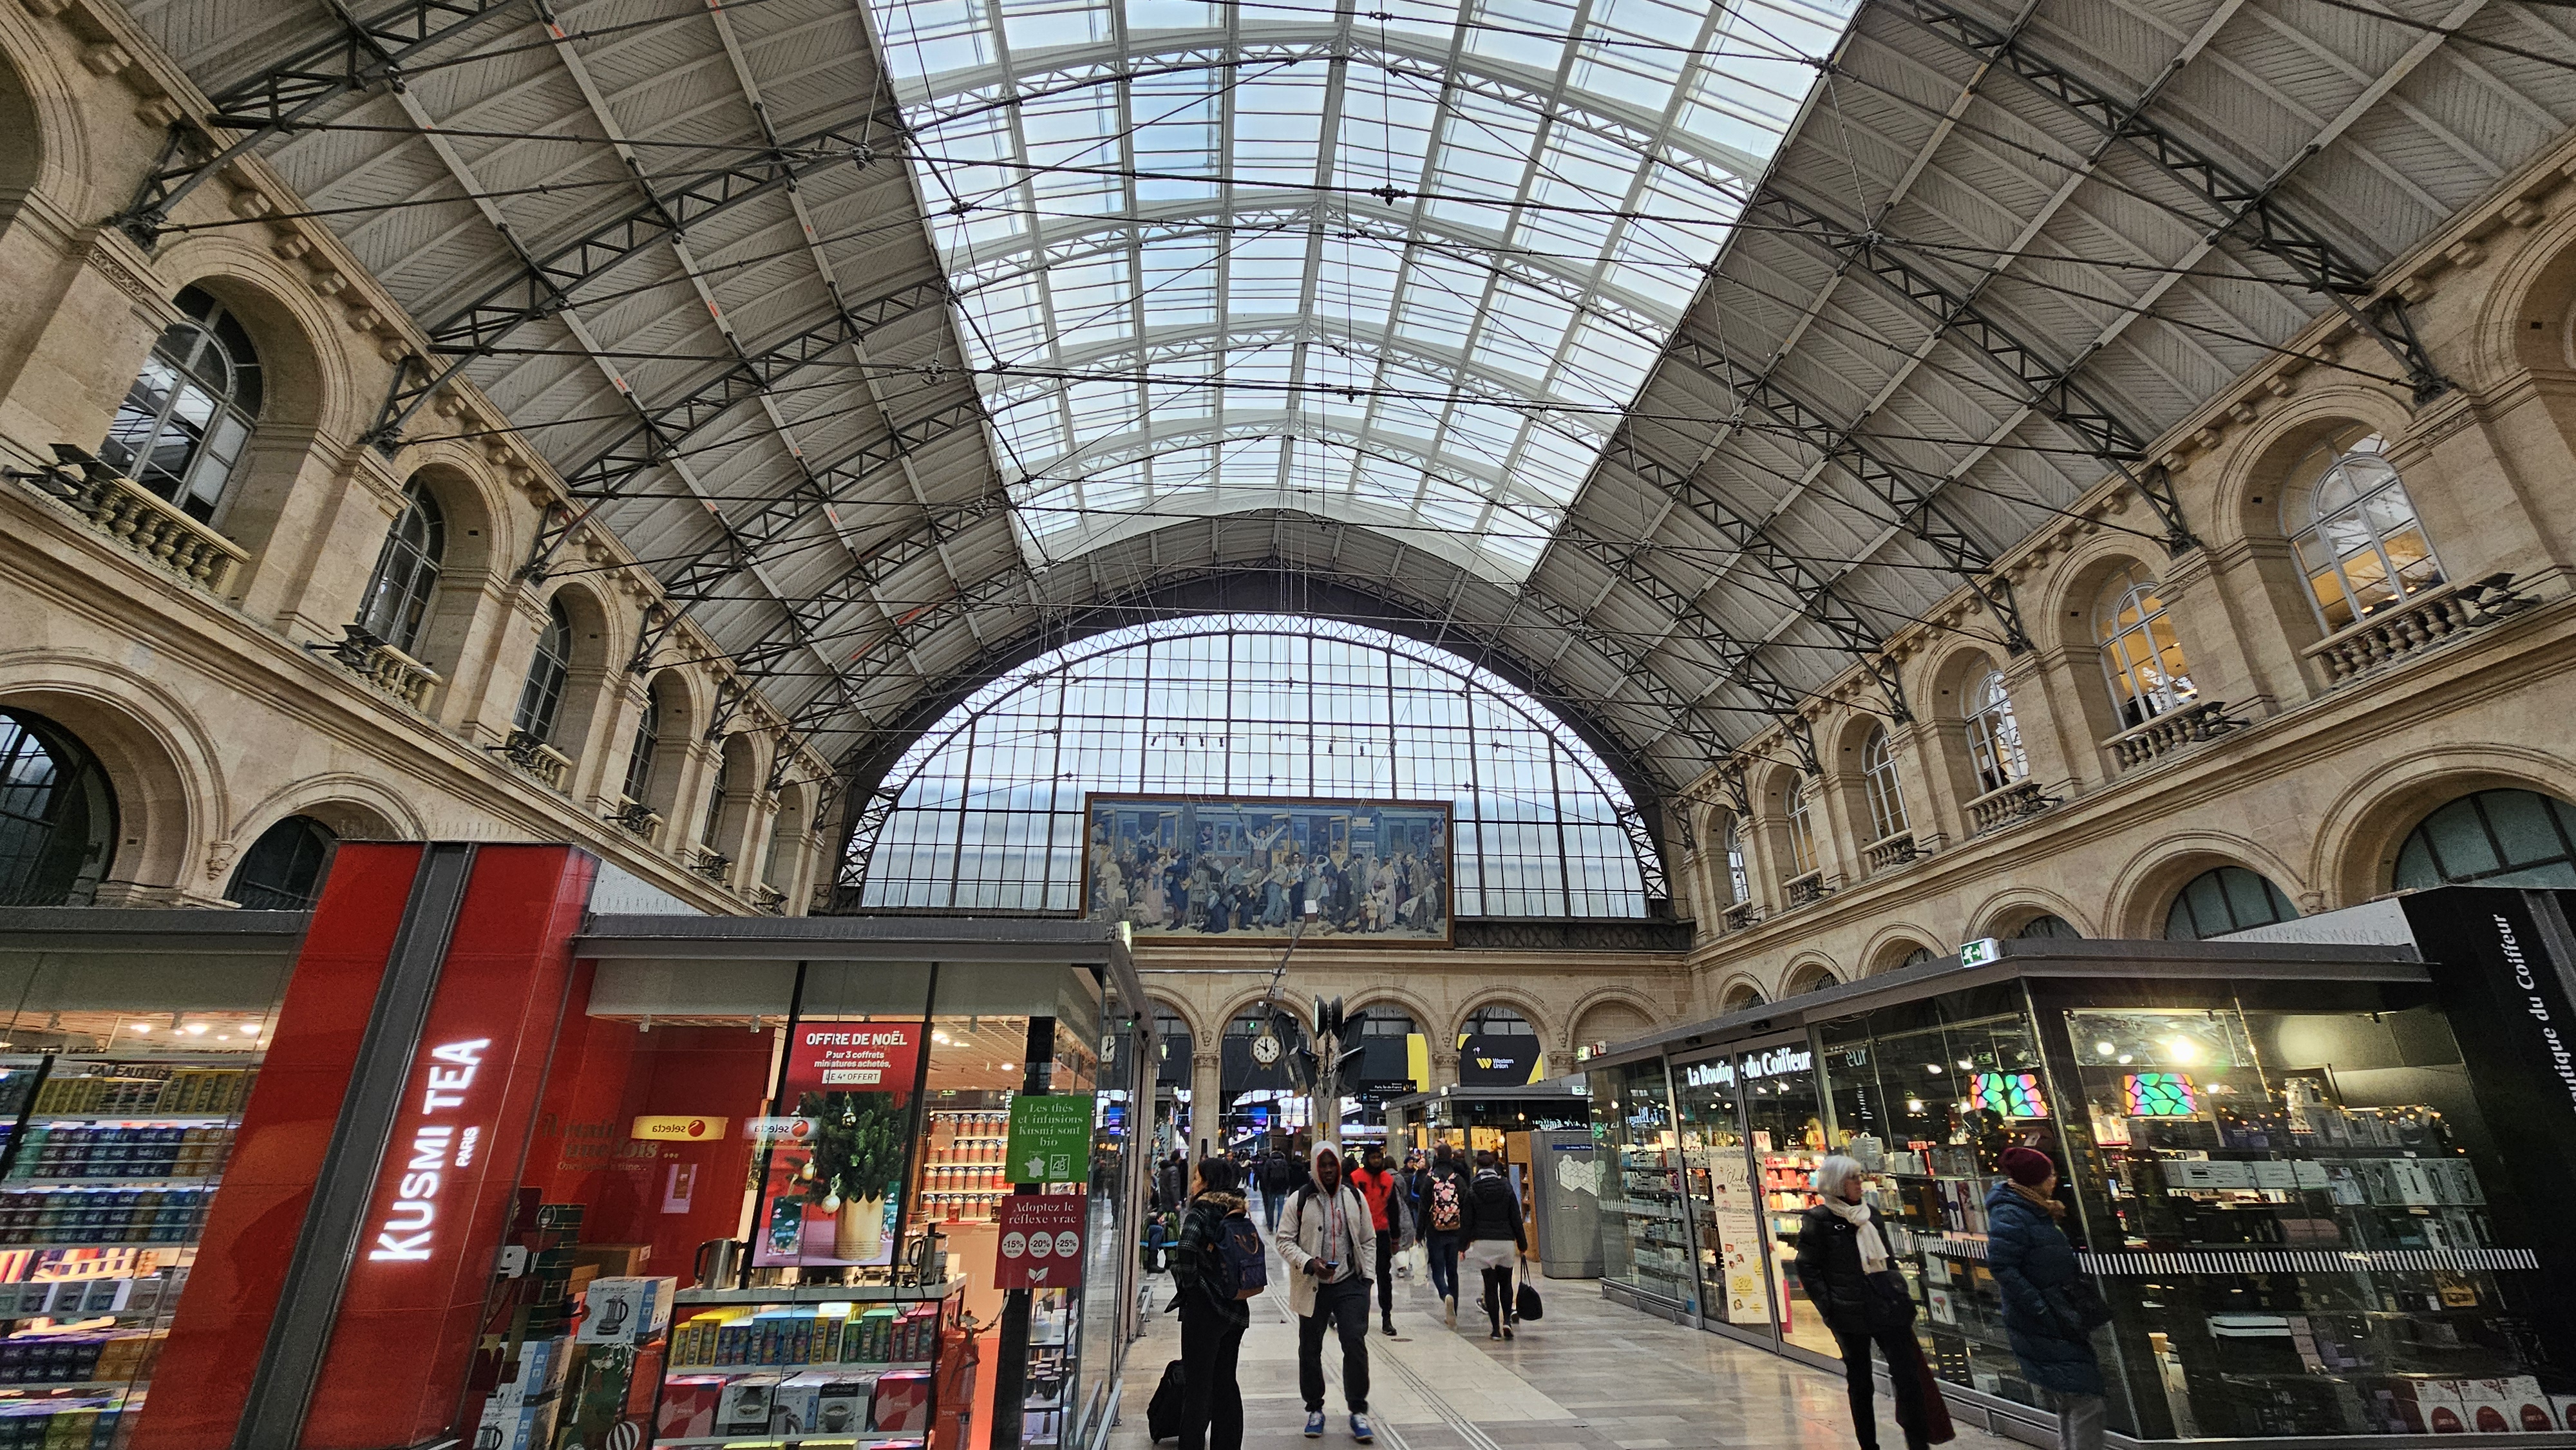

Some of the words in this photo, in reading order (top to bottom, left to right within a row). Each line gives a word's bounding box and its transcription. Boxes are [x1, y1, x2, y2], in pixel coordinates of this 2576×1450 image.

[2492, 914, 2535, 990] Coiffeur
[2528, 997, 2550, 1021] du
[806, 1033, 851, 1045] OFFRE
[851, 1033, 871, 1045] DE
[871, 1030, 907, 1046] NOËL
[852, 1050, 885, 1059] coffrets
[1687, 1066, 1701, 1087] La
[1699, 1060, 1745, 1088] Boutiq
[1745, 1055, 1763, 1078] du
[1761, 1047, 1812, 1077] Coiffeur
[1029, 1103, 1048, 1113] Les
[1052, 1103, 1074, 1113] thés
[1018, 1115, 1027, 1124] et
[1032, 1114, 1083, 1124] infusions
[1019, 1125, 1054, 1135] Kusmi
[1057, 1126, 1080, 1135] sont
[455, 1125, 480, 1167] PARIS
[1040, 1136, 1058, 1147] bio
[368, 1126, 455, 1261] KUSMI
[422, 1038, 491, 1115] TEA
[1052, 1159, 1066, 1171] AB
[1013, 1201, 1060, 1214] Adoptez
[1065, 1201, 1074, 1212] le
[1009, 1214, 1048, 1224] réflexe
